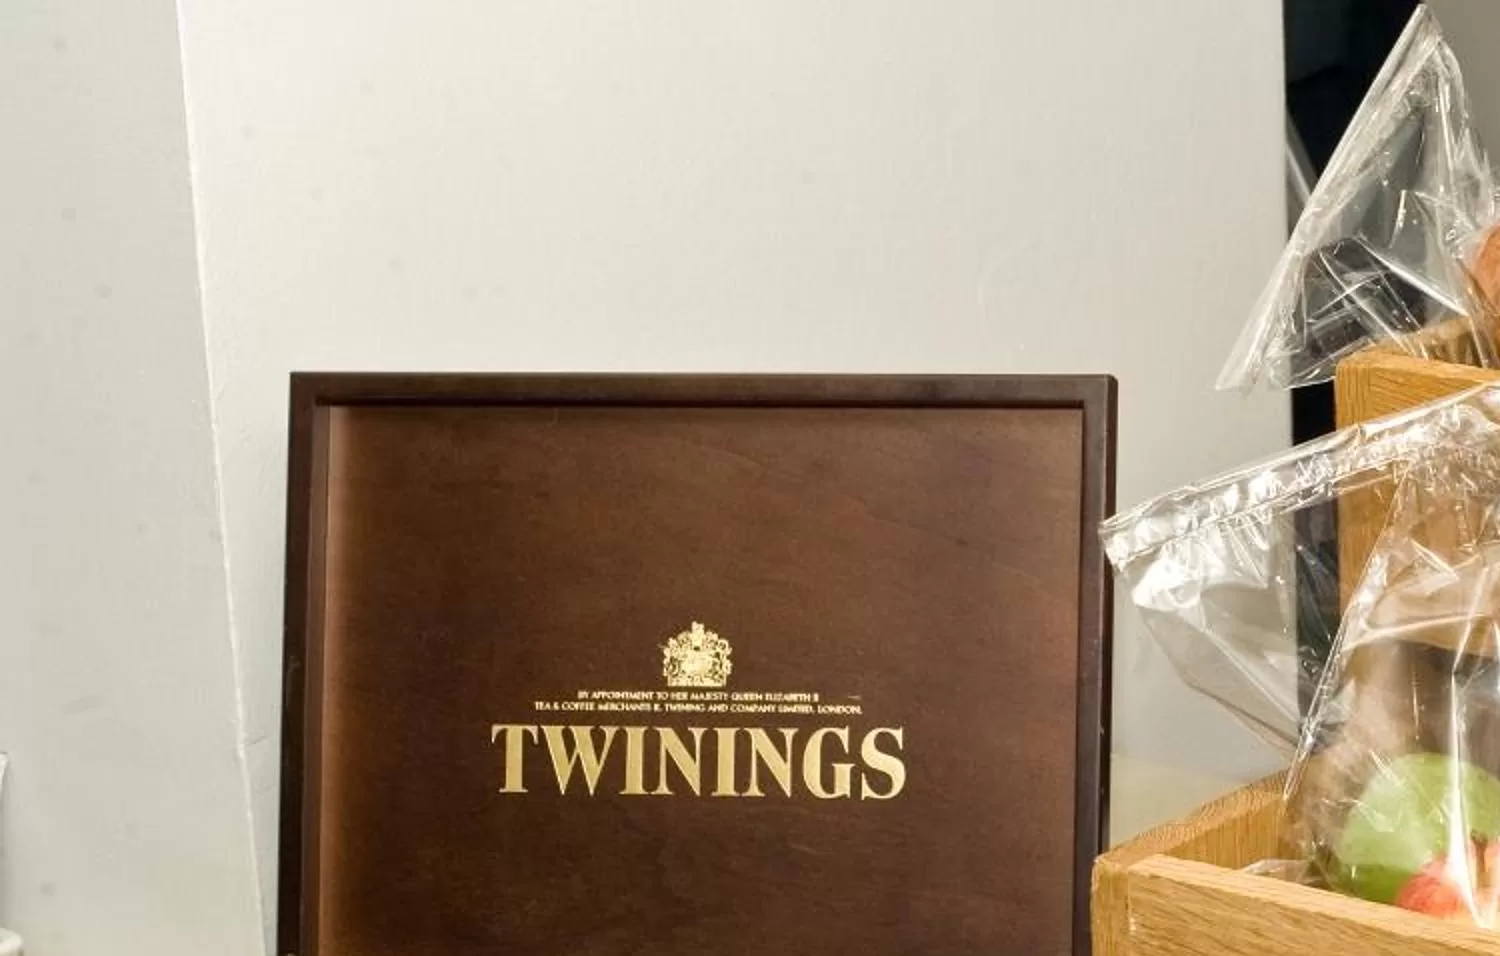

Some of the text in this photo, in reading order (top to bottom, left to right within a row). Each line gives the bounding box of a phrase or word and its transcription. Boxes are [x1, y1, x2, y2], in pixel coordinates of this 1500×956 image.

[577, 690, 589, 700] BY
[591, 690, 654, 700] APPOINTMENT
[656, 691, 669, 700] TO
[670, 691, 688, 701] HER
[690, 691, 728, 701] MAJESTY
[731, 692, 763, 702] QUEEN
[765, 692, 811, 702] ELIZABETH
[535, 701, 551, 711] TEA
[561, 701, 594, 711] COFFEE
[597, 702, 651, 712] MERCHANTS
[665, 703, 706, 713] TWINING
[707, 703, 728, 713] AND
[730, 703, 776, 713] COMPANY
[491, 724, 907, 801] TWININGS
